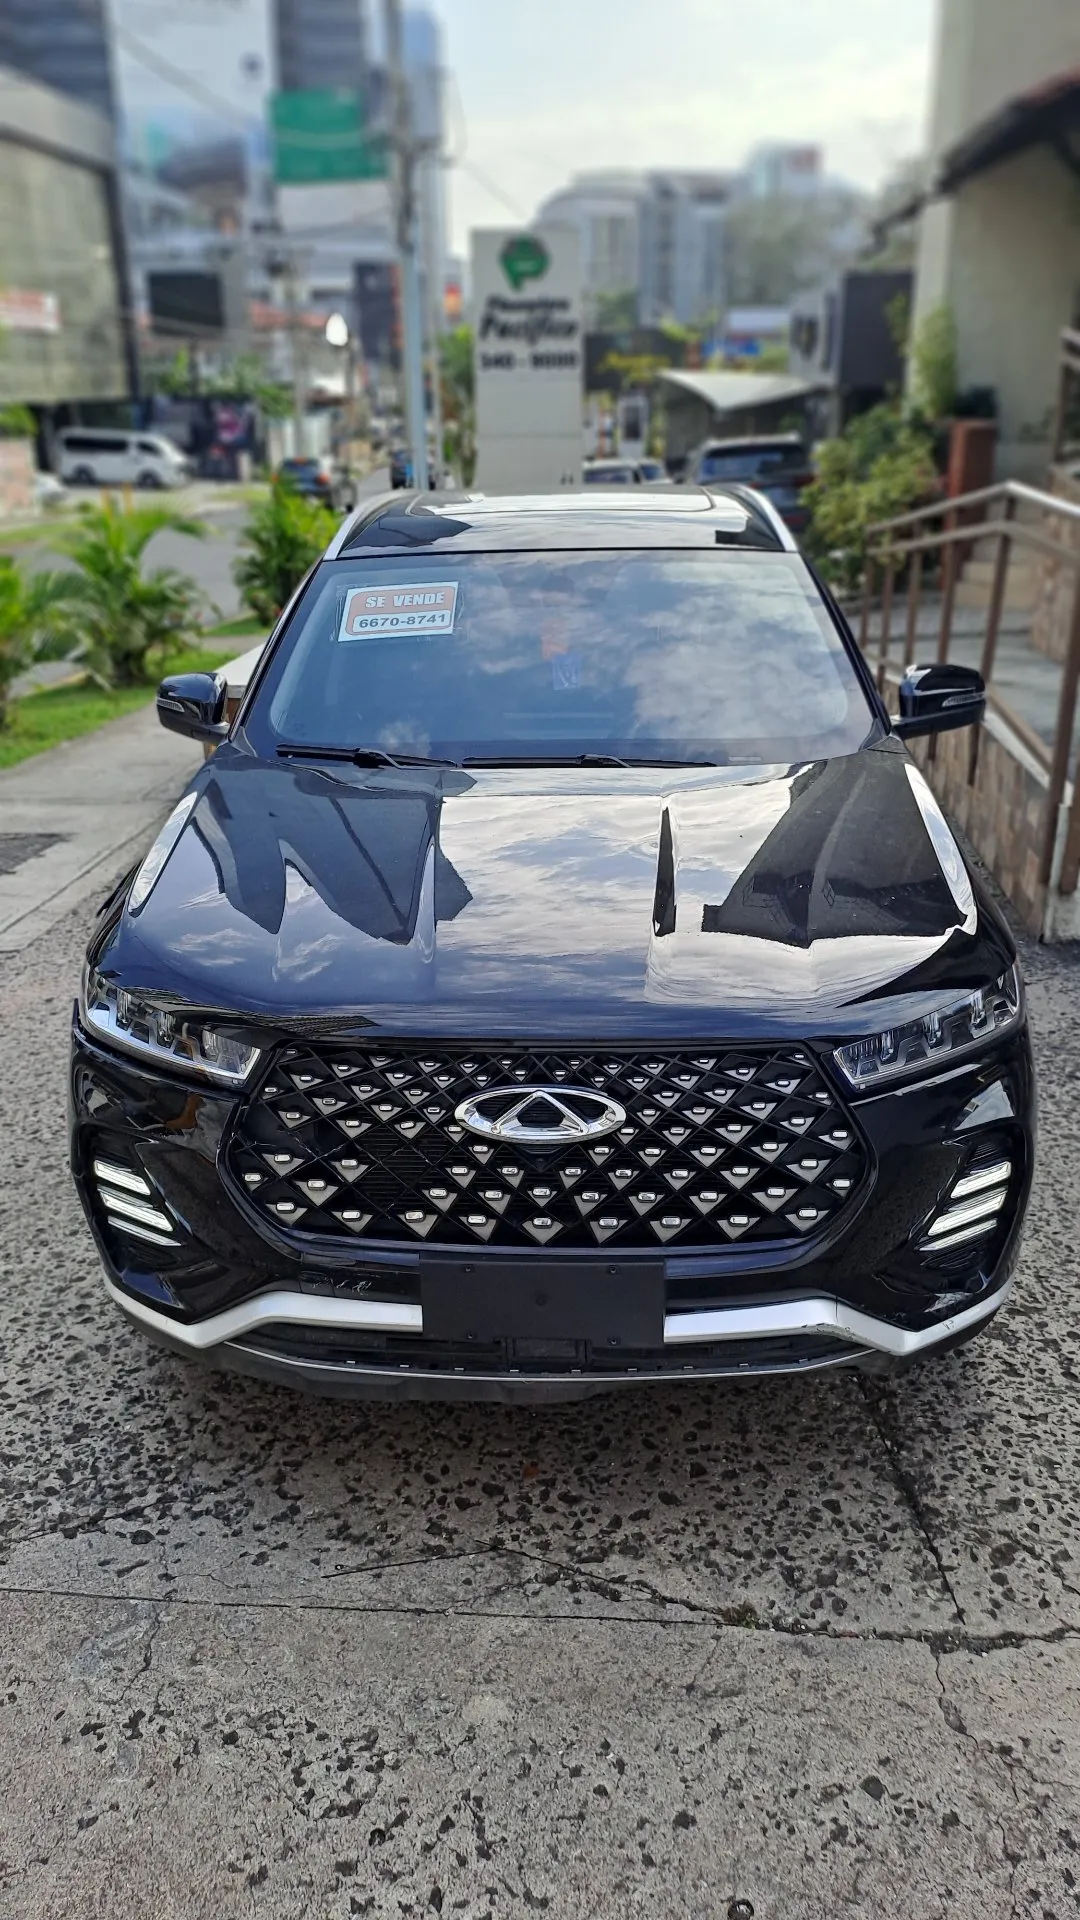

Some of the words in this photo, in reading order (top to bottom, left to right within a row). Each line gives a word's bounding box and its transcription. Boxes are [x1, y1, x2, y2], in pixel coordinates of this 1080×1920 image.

[365, 596, 386, 608] SE
[393, 592, 445, 607] VENDE
[359, 613, 446, 629] 6670-8741
